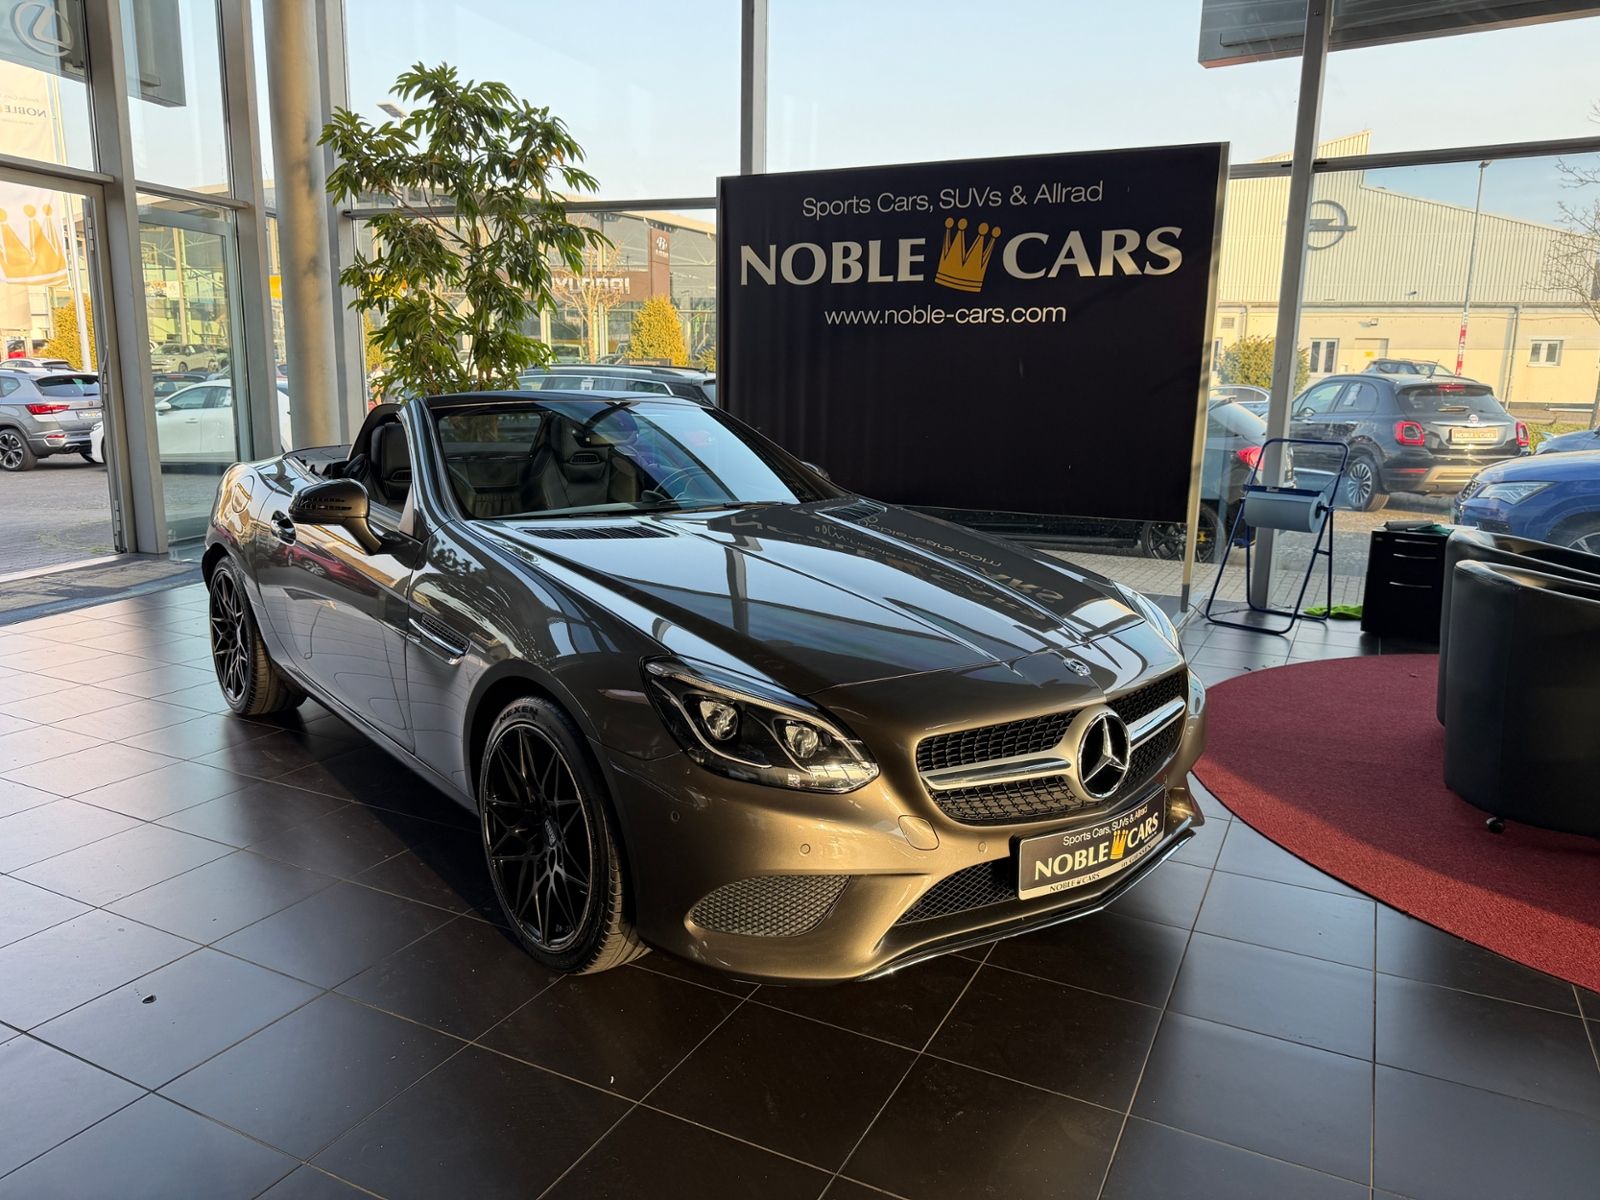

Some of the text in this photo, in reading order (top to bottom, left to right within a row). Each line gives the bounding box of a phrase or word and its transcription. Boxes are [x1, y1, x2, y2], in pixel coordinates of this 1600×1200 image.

[802, 180, 1104, 221] Sports Cars, SUVs & Allrad
[740, 226, 1183, 286] NOBLE CARS
[824, 304, 1067, 325] www.noble-cars.com
[499, 705, 538, 724] NEXEN
[1034, 812, 1159, 881] NOBLE CARS
[1062, 831, 1091, 847] Sports
[1111, 817, 1130, 832] SUVs
[1049, 873, 1100, 892] NOBLE CARS
